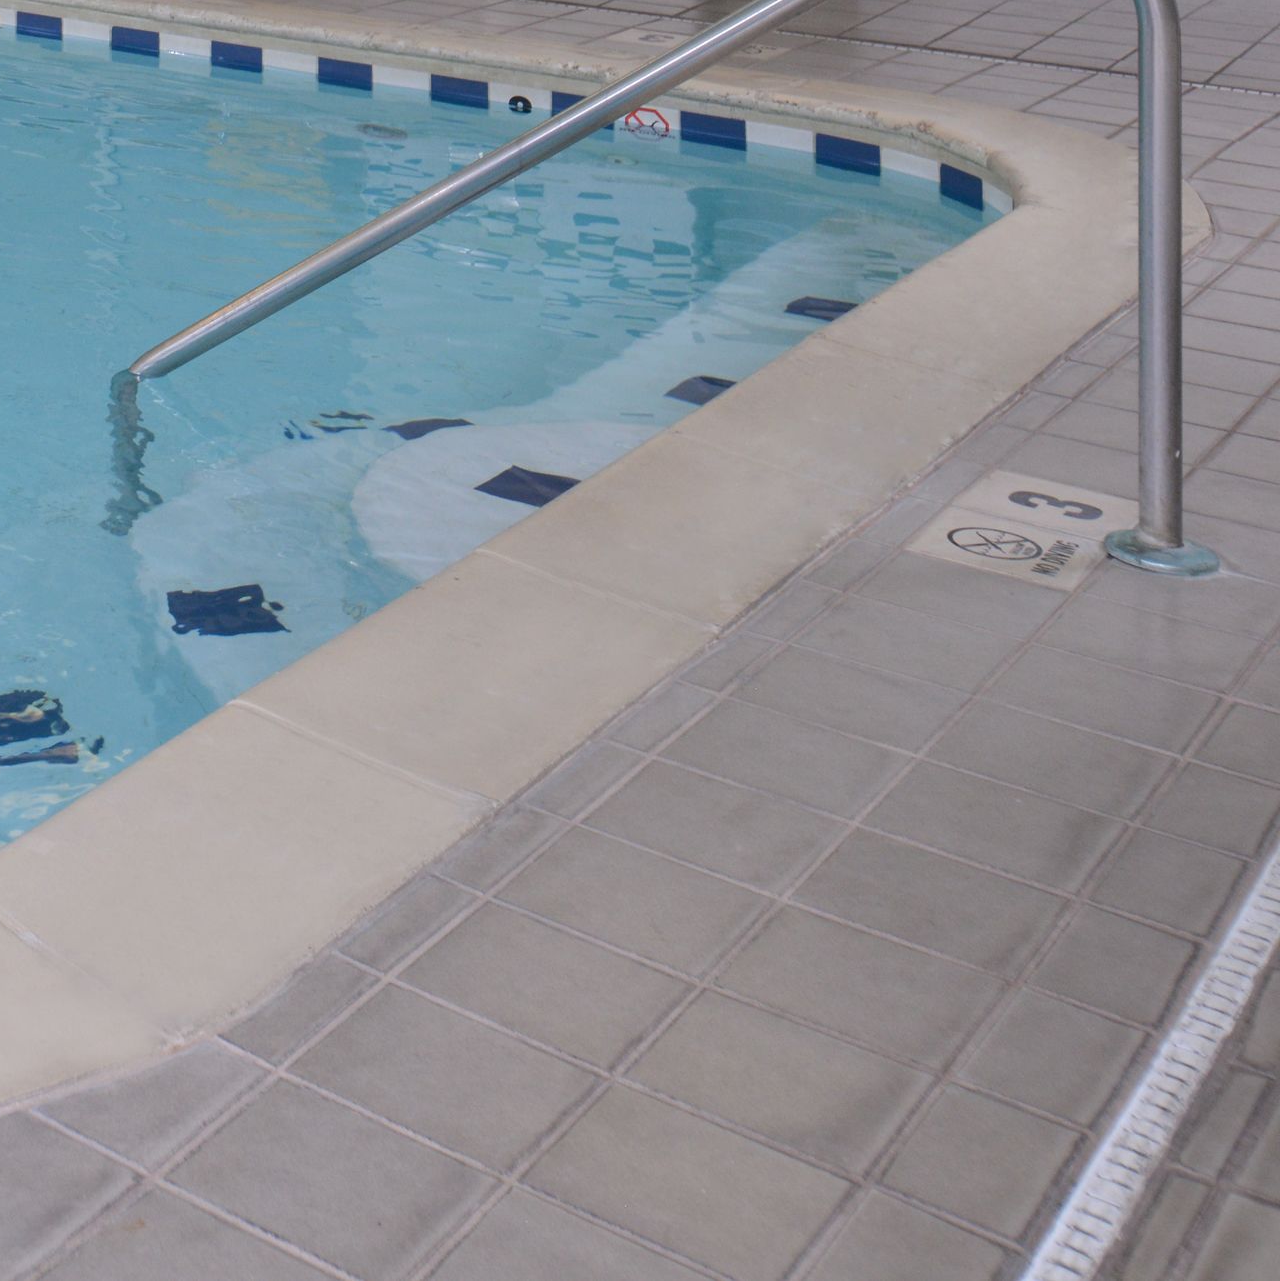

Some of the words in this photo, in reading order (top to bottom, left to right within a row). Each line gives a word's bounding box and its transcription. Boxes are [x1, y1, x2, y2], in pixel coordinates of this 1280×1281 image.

[1008, 490, 1104, 520] 3
[1040, 539, 1080, 566] DIVING
[1030, 562, 1061, 577] NO
